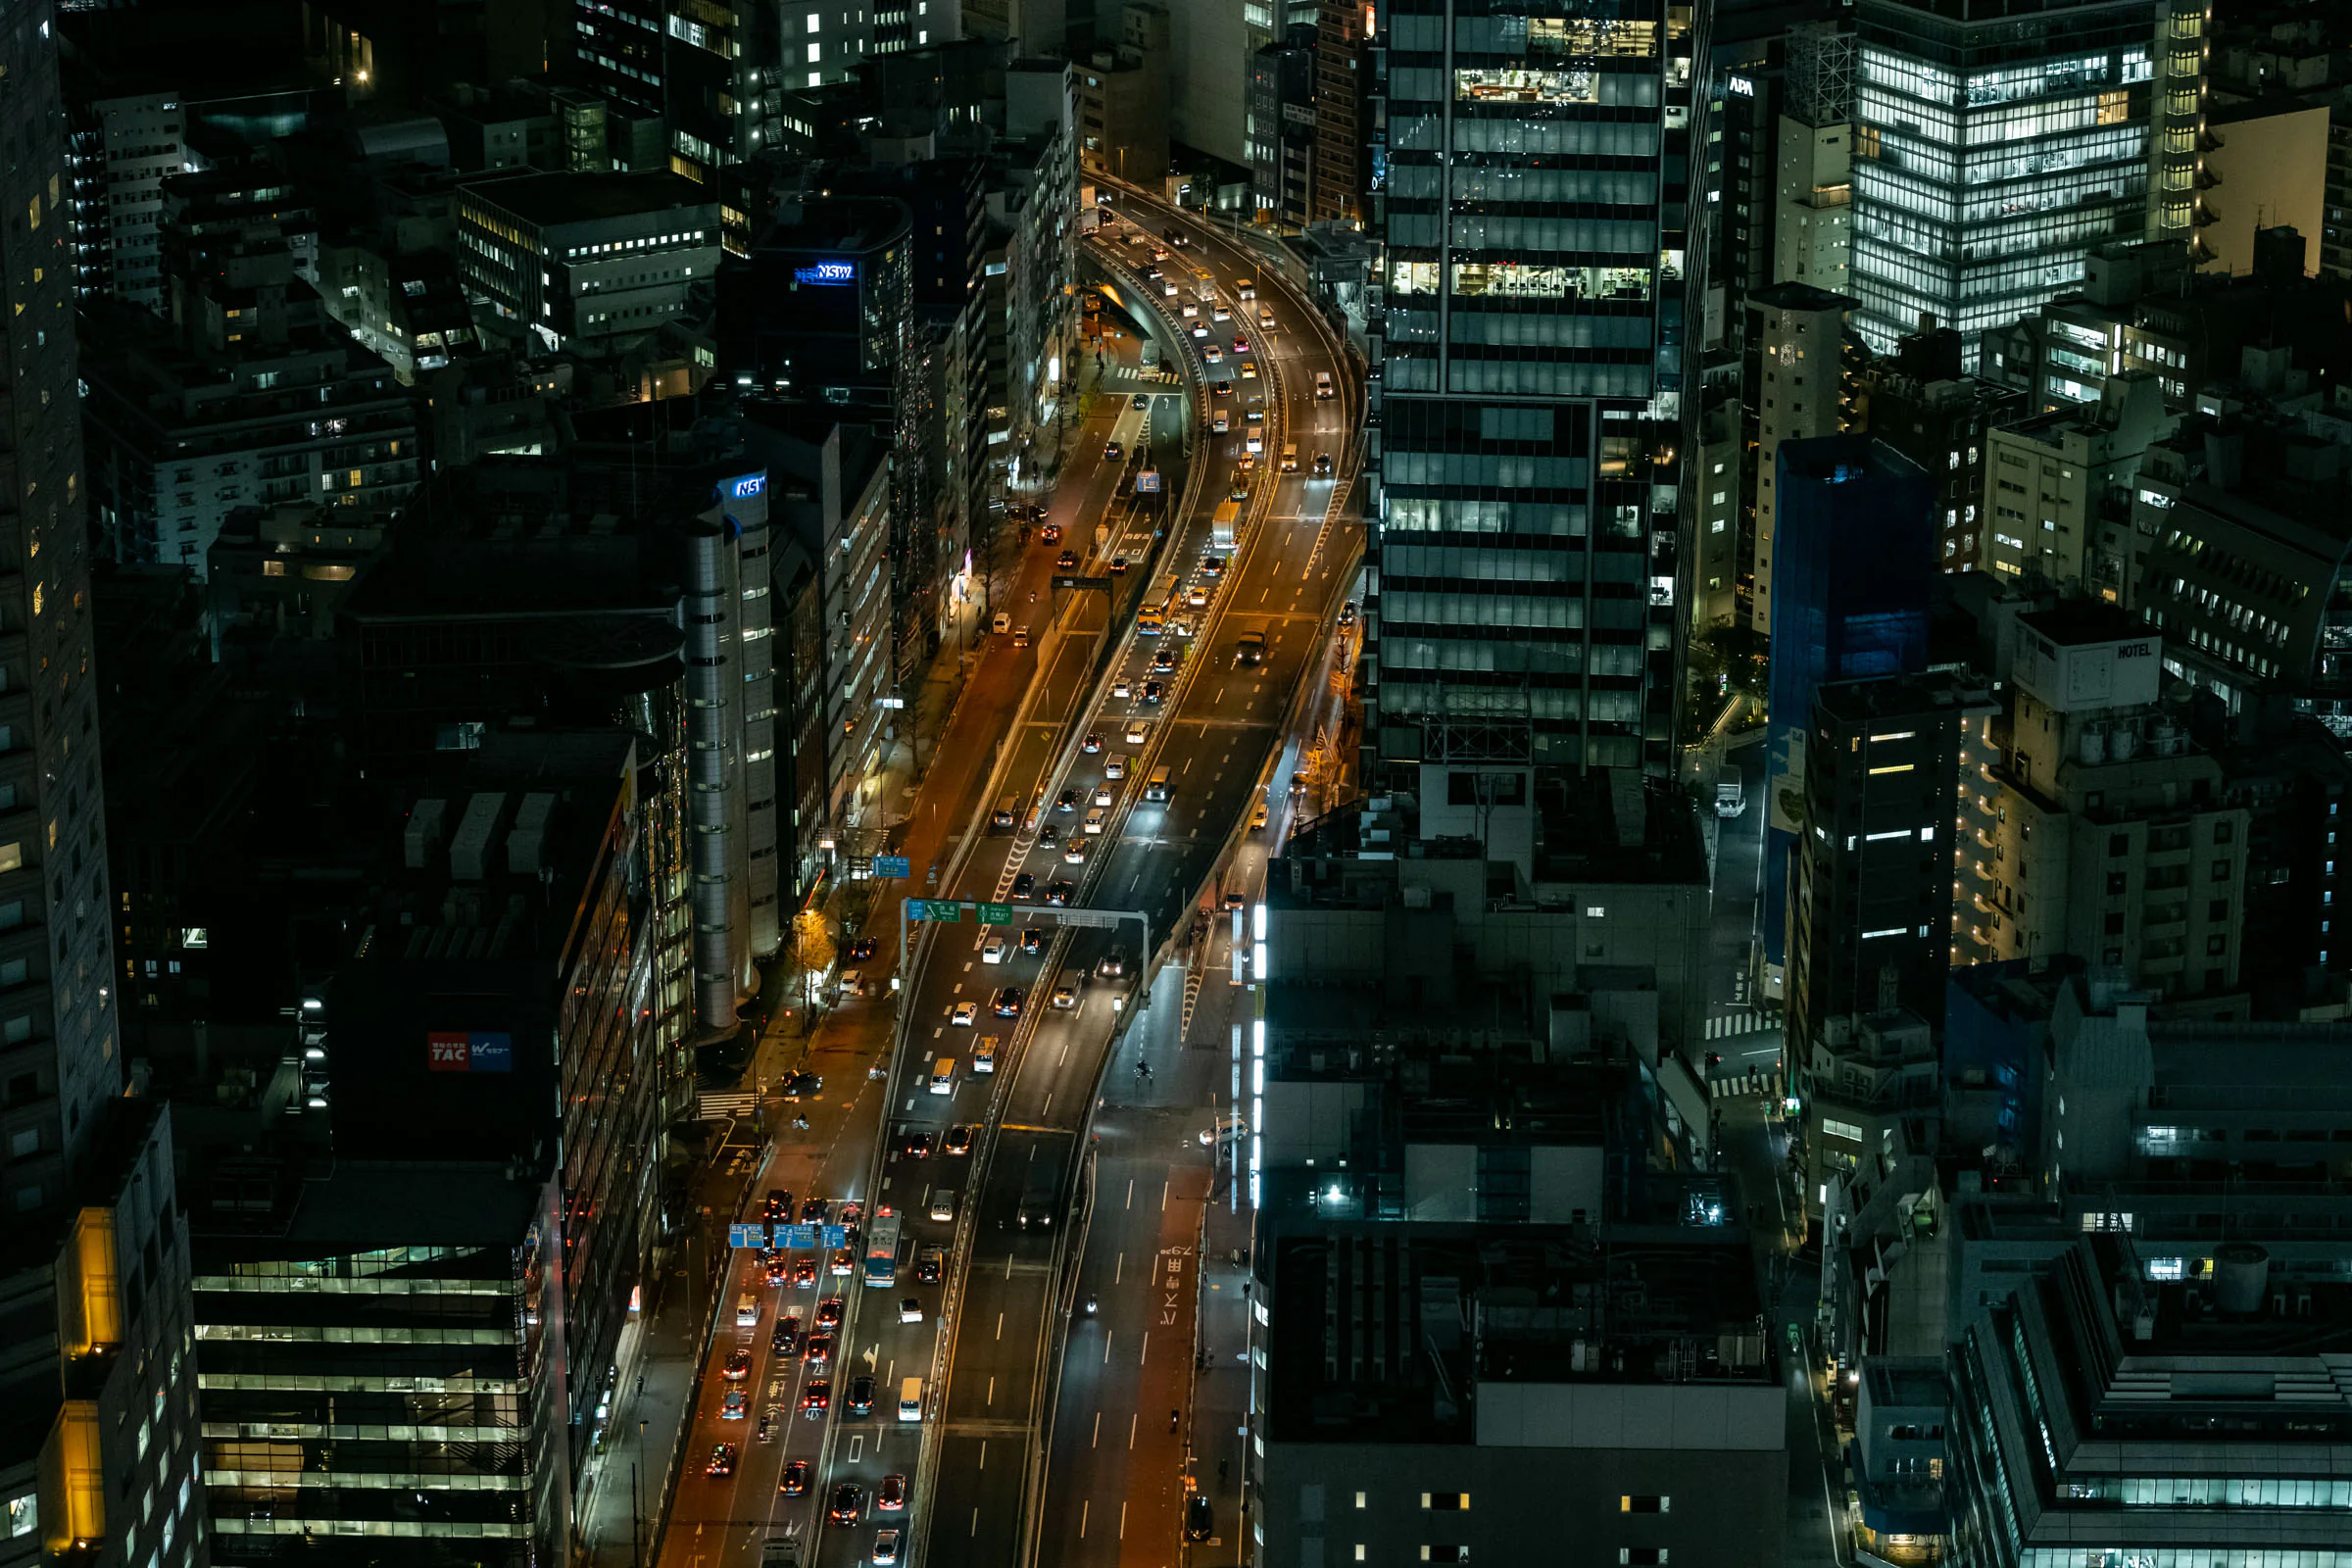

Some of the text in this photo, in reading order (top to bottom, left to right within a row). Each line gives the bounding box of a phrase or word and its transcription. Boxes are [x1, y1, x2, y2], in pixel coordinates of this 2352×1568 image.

[1730, 77, 1753, 96] APA
[816, 265, 852, 279] NSW
[2118, 643, 2151, 659] HOTEL
[432, 1049, 466, 1061] TAC
